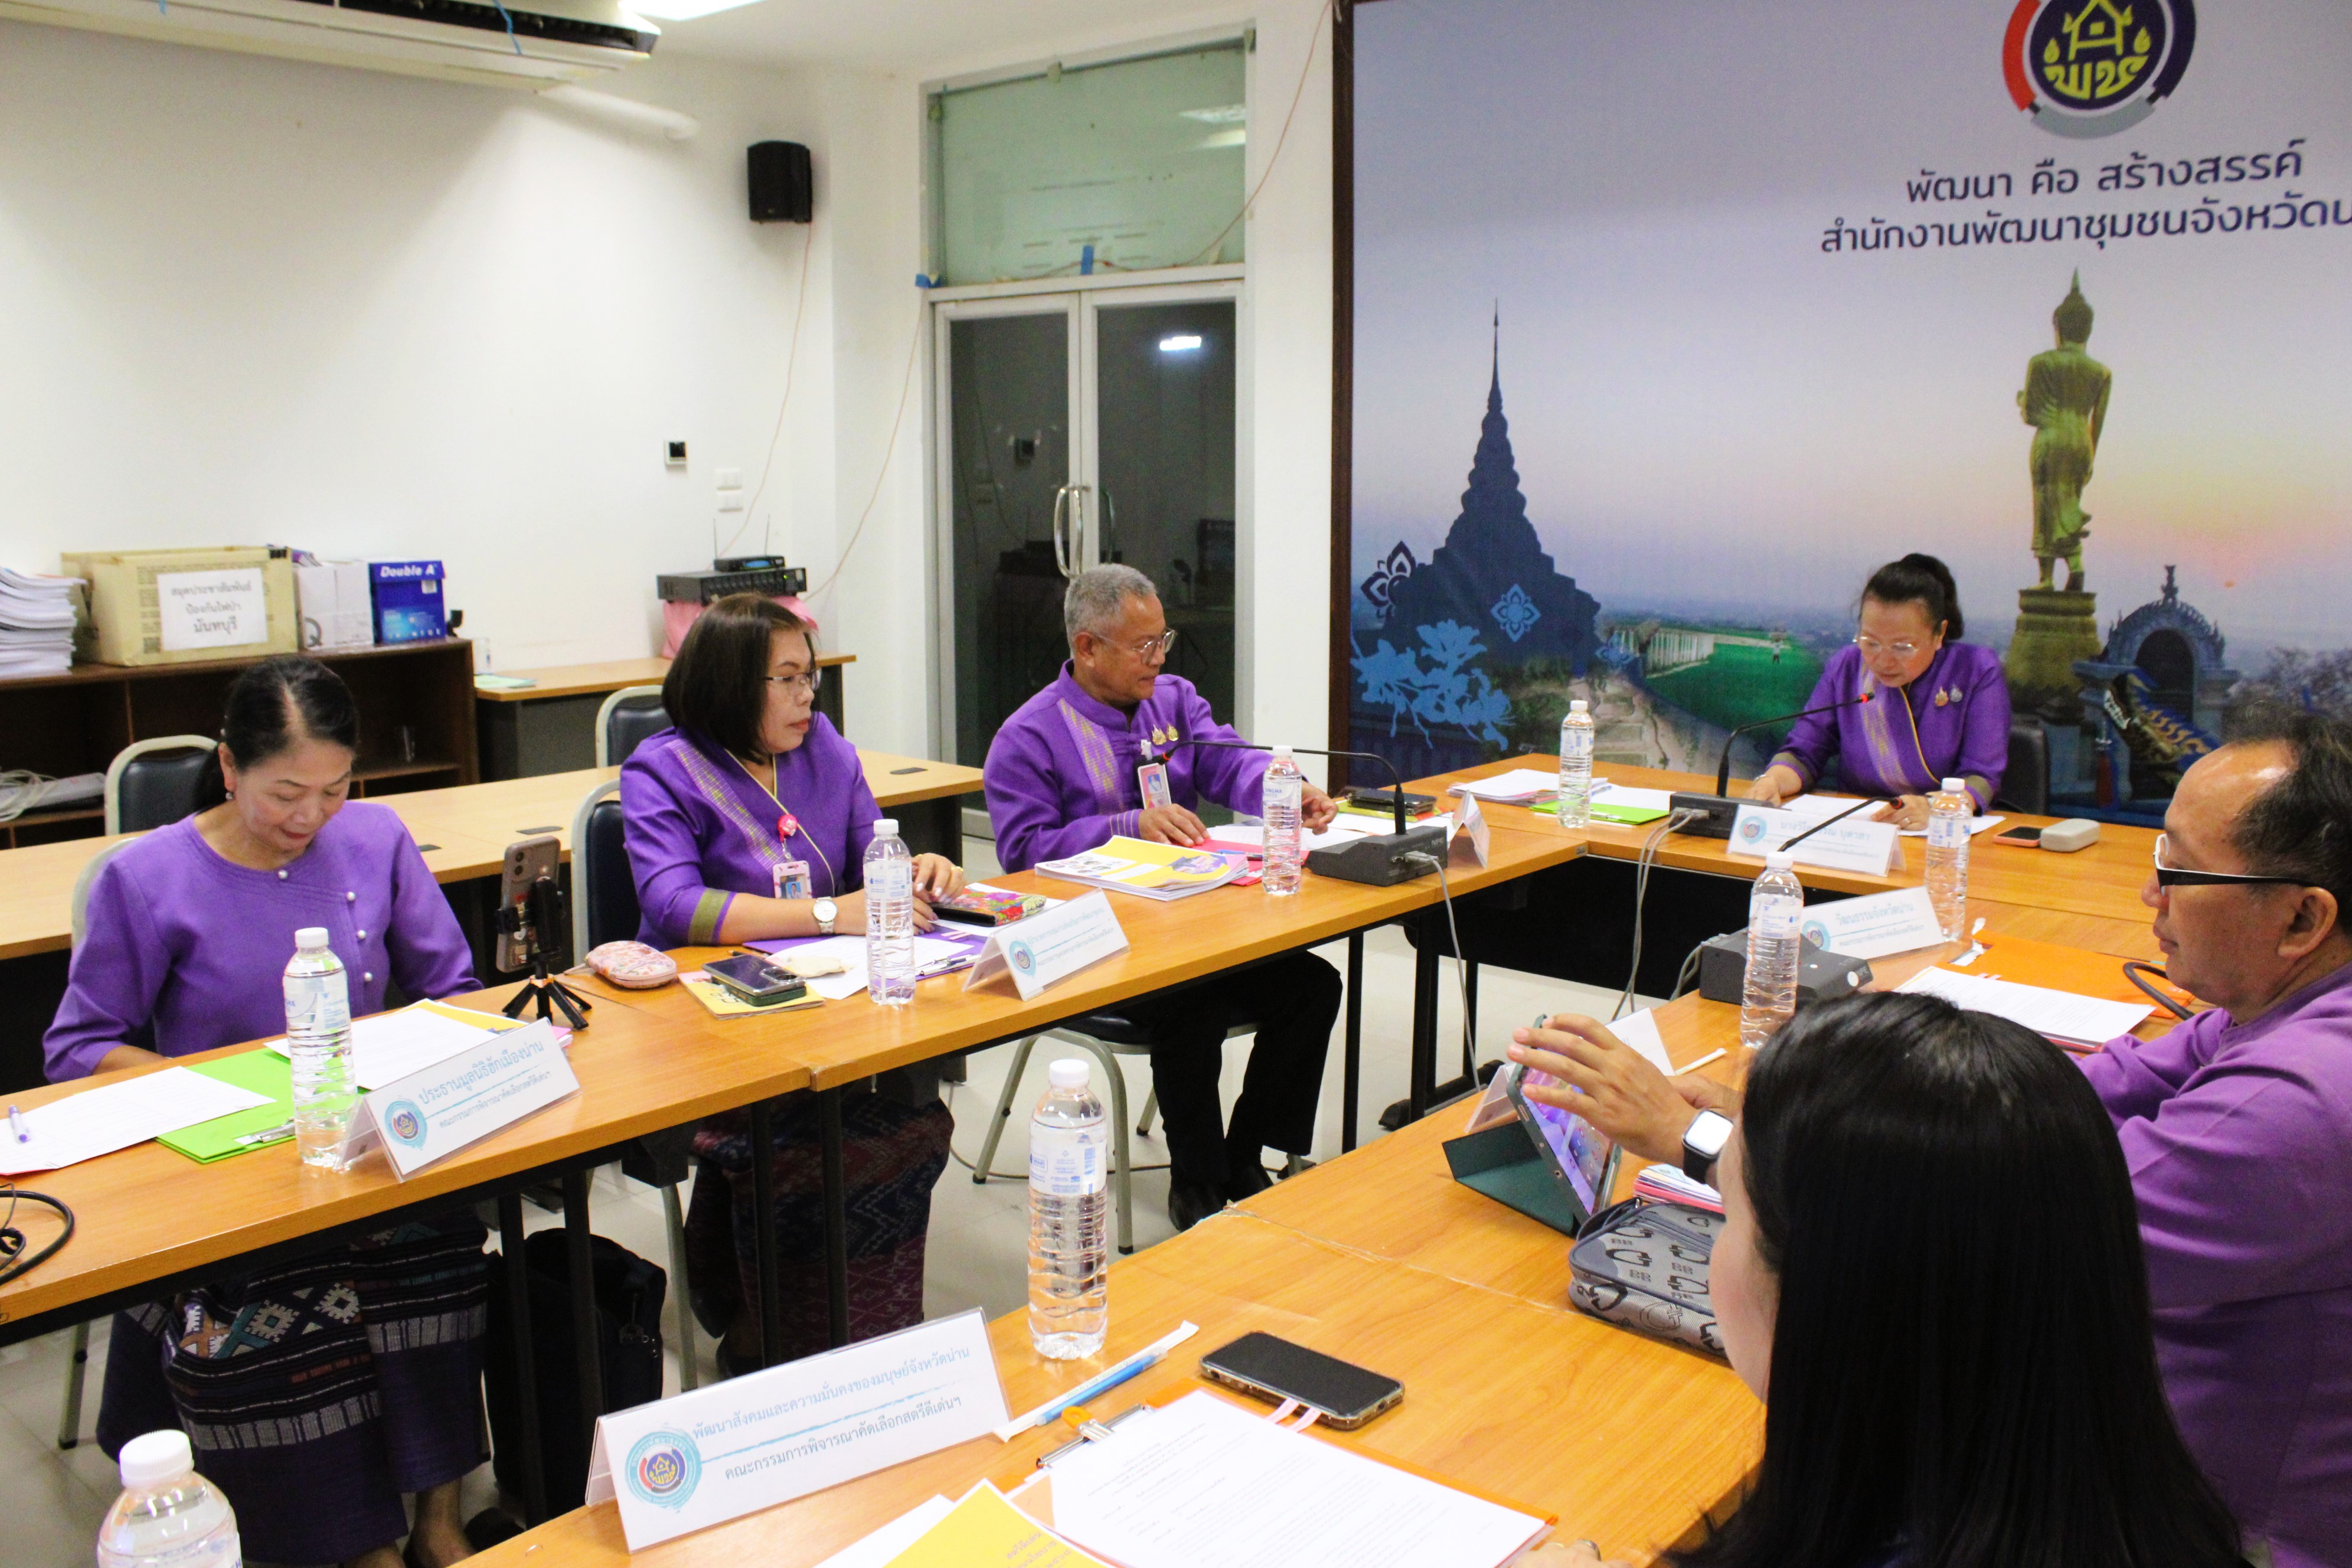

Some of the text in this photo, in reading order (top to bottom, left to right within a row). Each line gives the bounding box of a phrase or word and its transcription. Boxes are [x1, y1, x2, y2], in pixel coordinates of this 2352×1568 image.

[1907, 139, 2306, 203] พัฒนา คือ สร้างสรรค์
[380, 564, 435, 577] Double A
[418, 1041, 544, 1106] ประธานมูลนิธิฮักเมืองน่าน
[692, 1346, 971, 1441] พัฒนาสังคมและความมั่นคงของมนุษย์จังหวัดน่าน
[725, 1397, 963, 1481] คณะกรรมการพิจารณาคัดเลือกสตรีดีเด่นฯ
